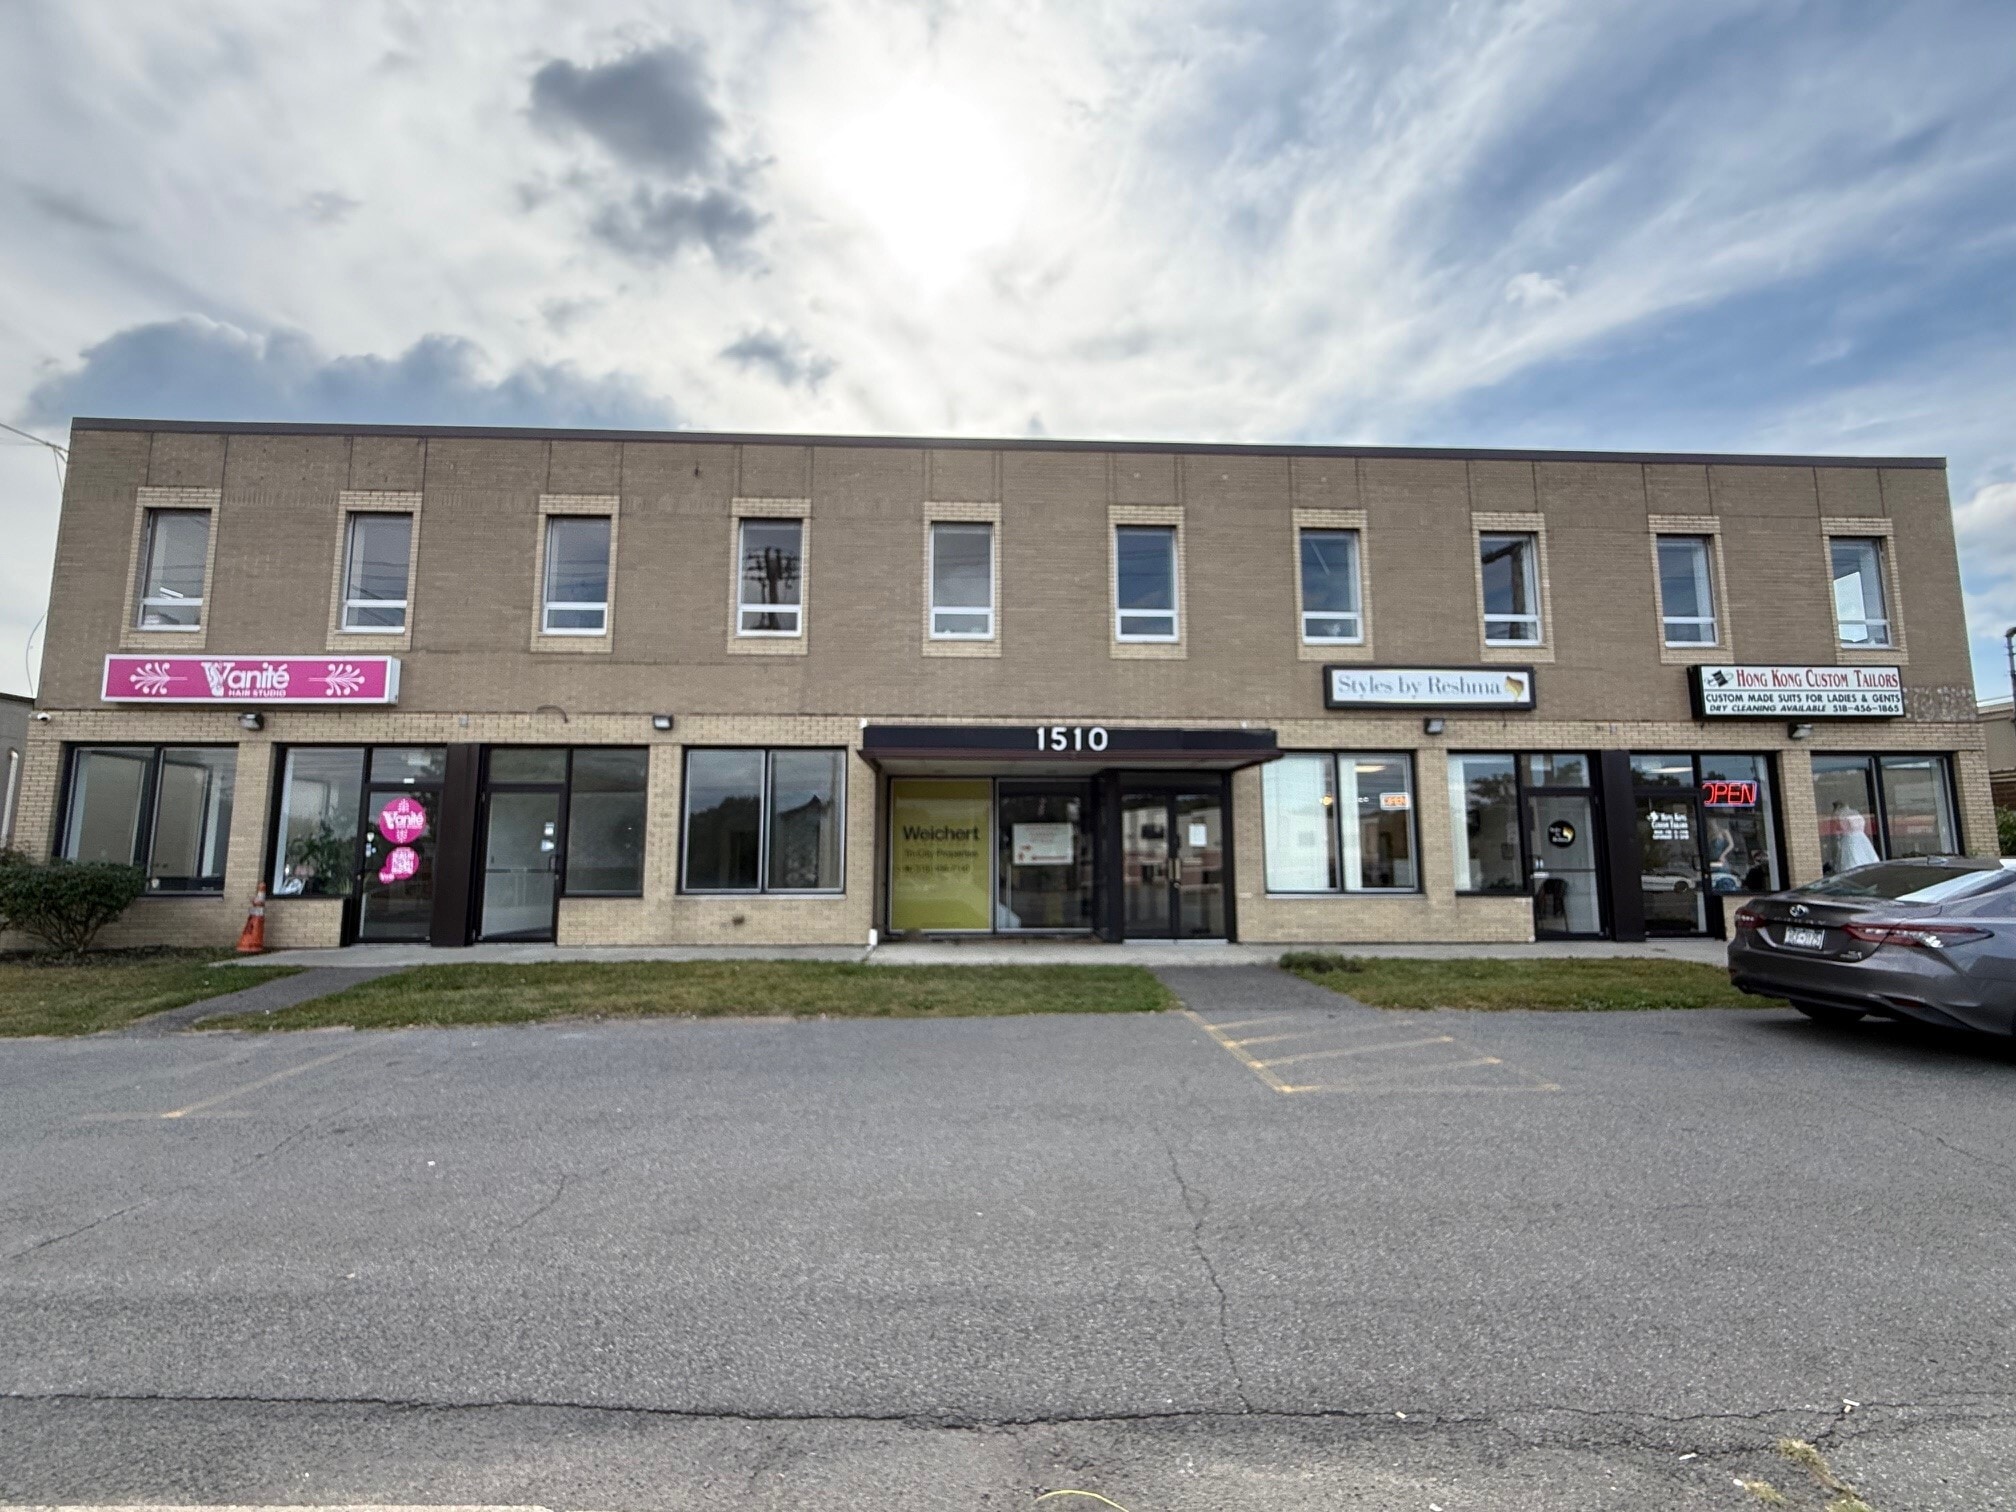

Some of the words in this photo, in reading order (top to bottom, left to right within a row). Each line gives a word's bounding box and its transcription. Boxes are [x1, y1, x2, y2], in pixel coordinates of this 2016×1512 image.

[200, 661, 290, 697] Vanité
[1338, 675, 1393, 699] Styles
[1398, 676, 1421, 700] by
[1428, 676, 1502, 695] Reshma
[1736, 669, 1768, 687] HONG
[1771, 669, 1803, 687] KONG
[1805, 669, 1849, 688] CUSTOM
[1853, 669, 1899, 688] TAILORS
[1706, 693, 1744, 703] CUSTOM
[1748, 693, 1774, 703] MADE
[1778, 693, 1802, 703] SUITS
[1805, 693, 1823, 703] FOR
[1826, 693, 1857, 703] LADIES
[1861, 693, 1868, 703] &
[1872, 694, 1900, 703] GENTS
[1709, 704, 1728, 712] DRY
[1732, 704, 1776, 712] CLEANING
[1780, 704, 1826, 712] AVAILABLE
[1832, 704, 1900, 712] 518-456-1865
[1037, 726, 1109, 752] 1510
[902, 825, 980, 841] Weichert
